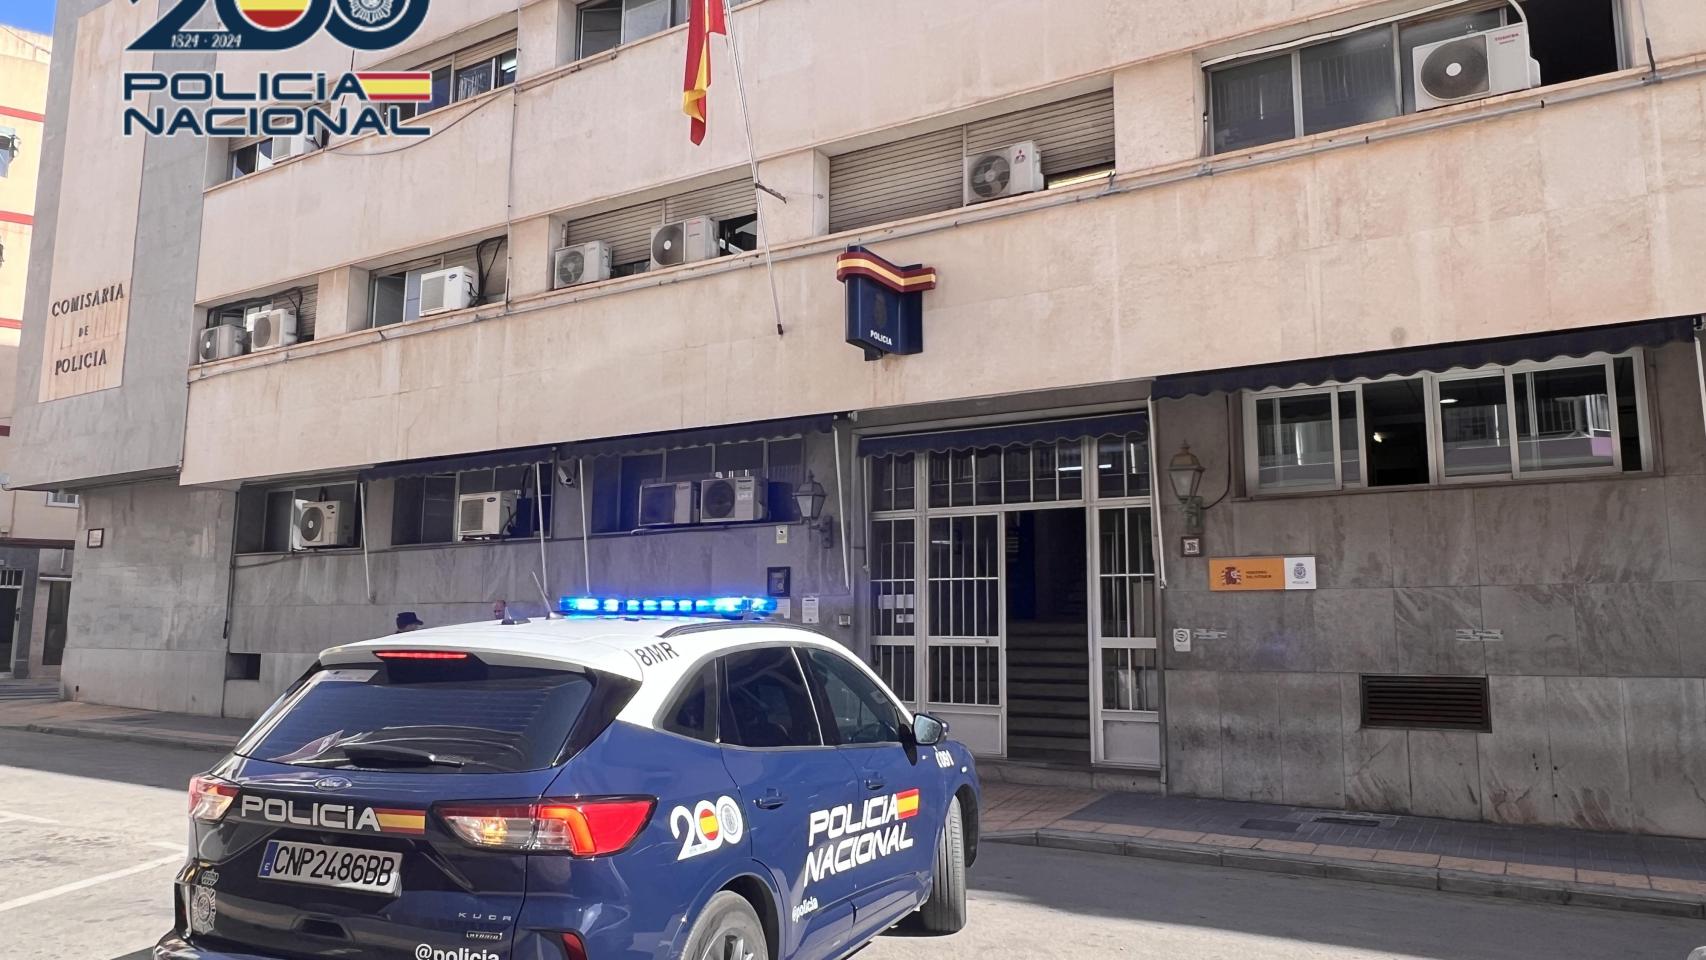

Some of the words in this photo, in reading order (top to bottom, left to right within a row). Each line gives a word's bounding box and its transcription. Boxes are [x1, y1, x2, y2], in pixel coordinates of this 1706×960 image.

[51, 283, 124, 317] COMISARIA
[78, 325, 89, 337] DE
[870, 329, 893, 346] POLICIA
[55, 349, 107, 376] POLICIA
[634, 641, 679, 666] 8MR
[670, 795, 744, 861] 200
[264, 862, 271, 871] E
[273, 846, 395, 886] CNP2486BB
[803, 822, 914, 888] NACIONAL
